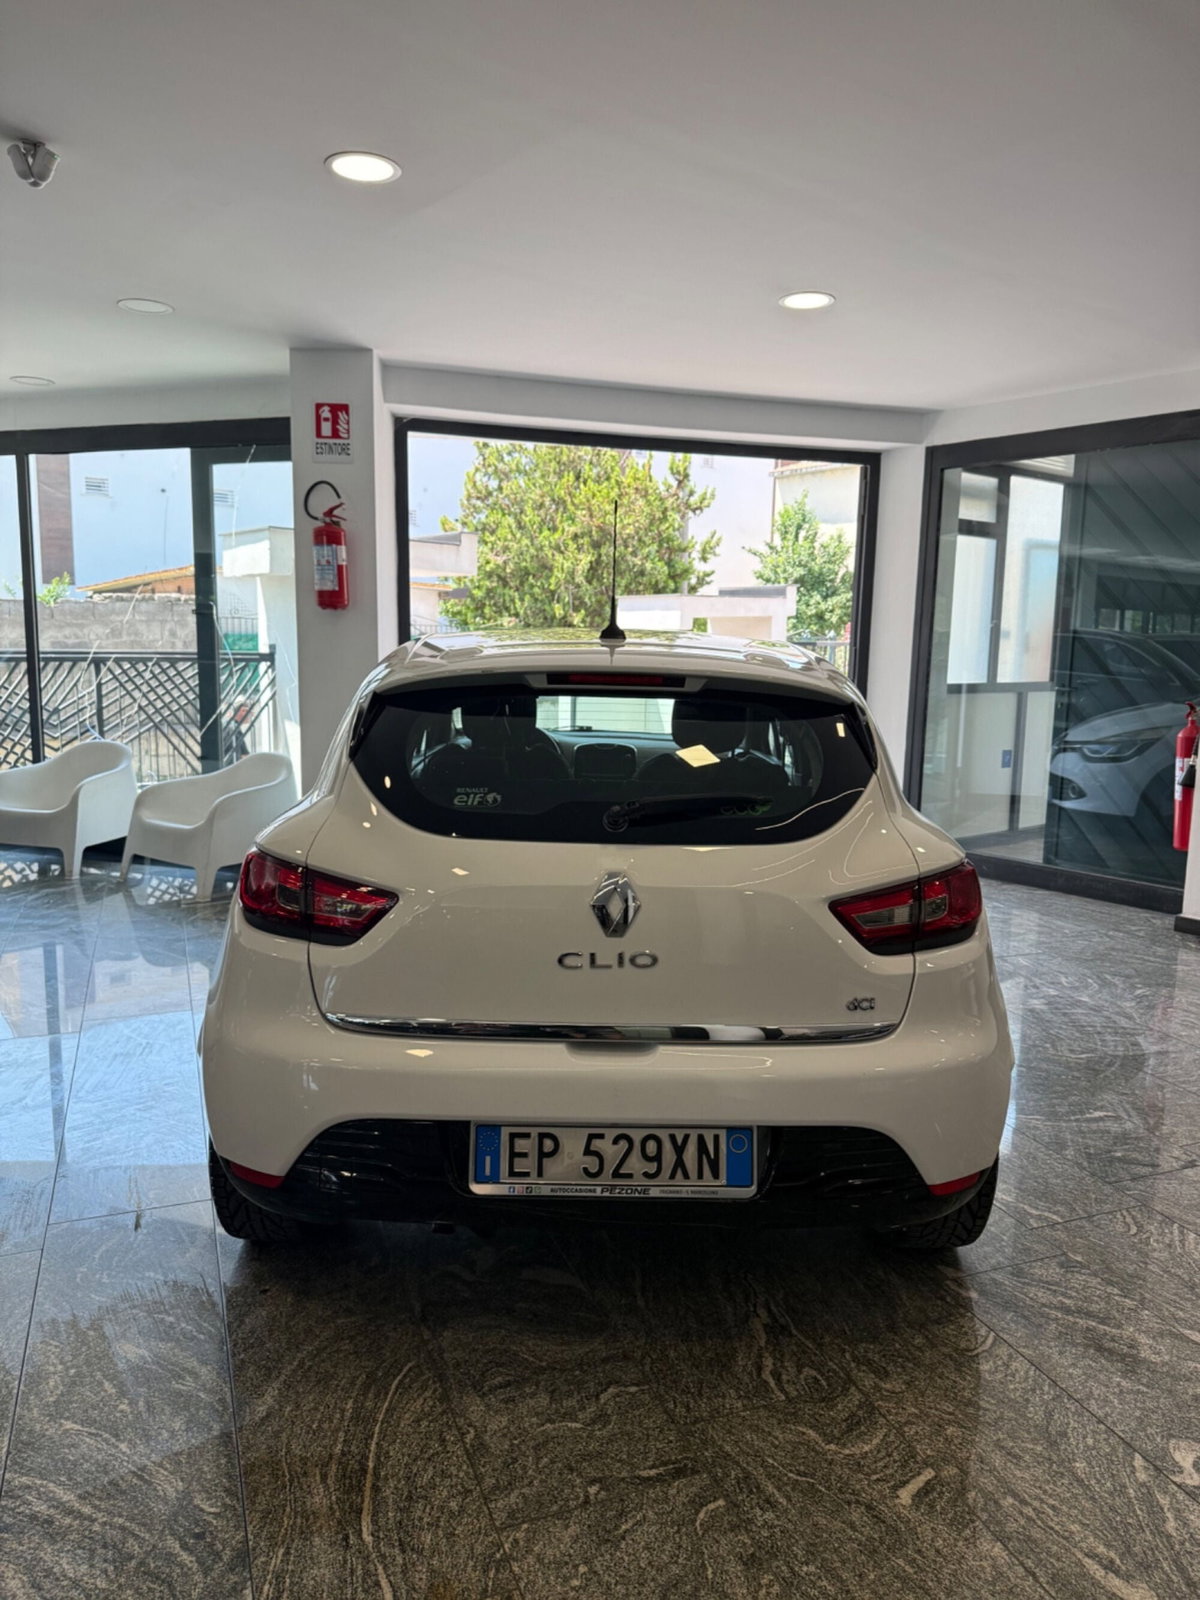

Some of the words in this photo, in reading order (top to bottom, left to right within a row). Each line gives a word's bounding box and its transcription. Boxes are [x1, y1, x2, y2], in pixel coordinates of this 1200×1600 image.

[315, 441, 351, 456] ESTINTORE
[453, 793, 484, 806] elf
[557, 951, 659, 970] CLIO
[507, 1131, 560, 1178] EP
[581, 1132, 720, 1180] 529XN
[600, 1186, 652, 1196] PEZONE
